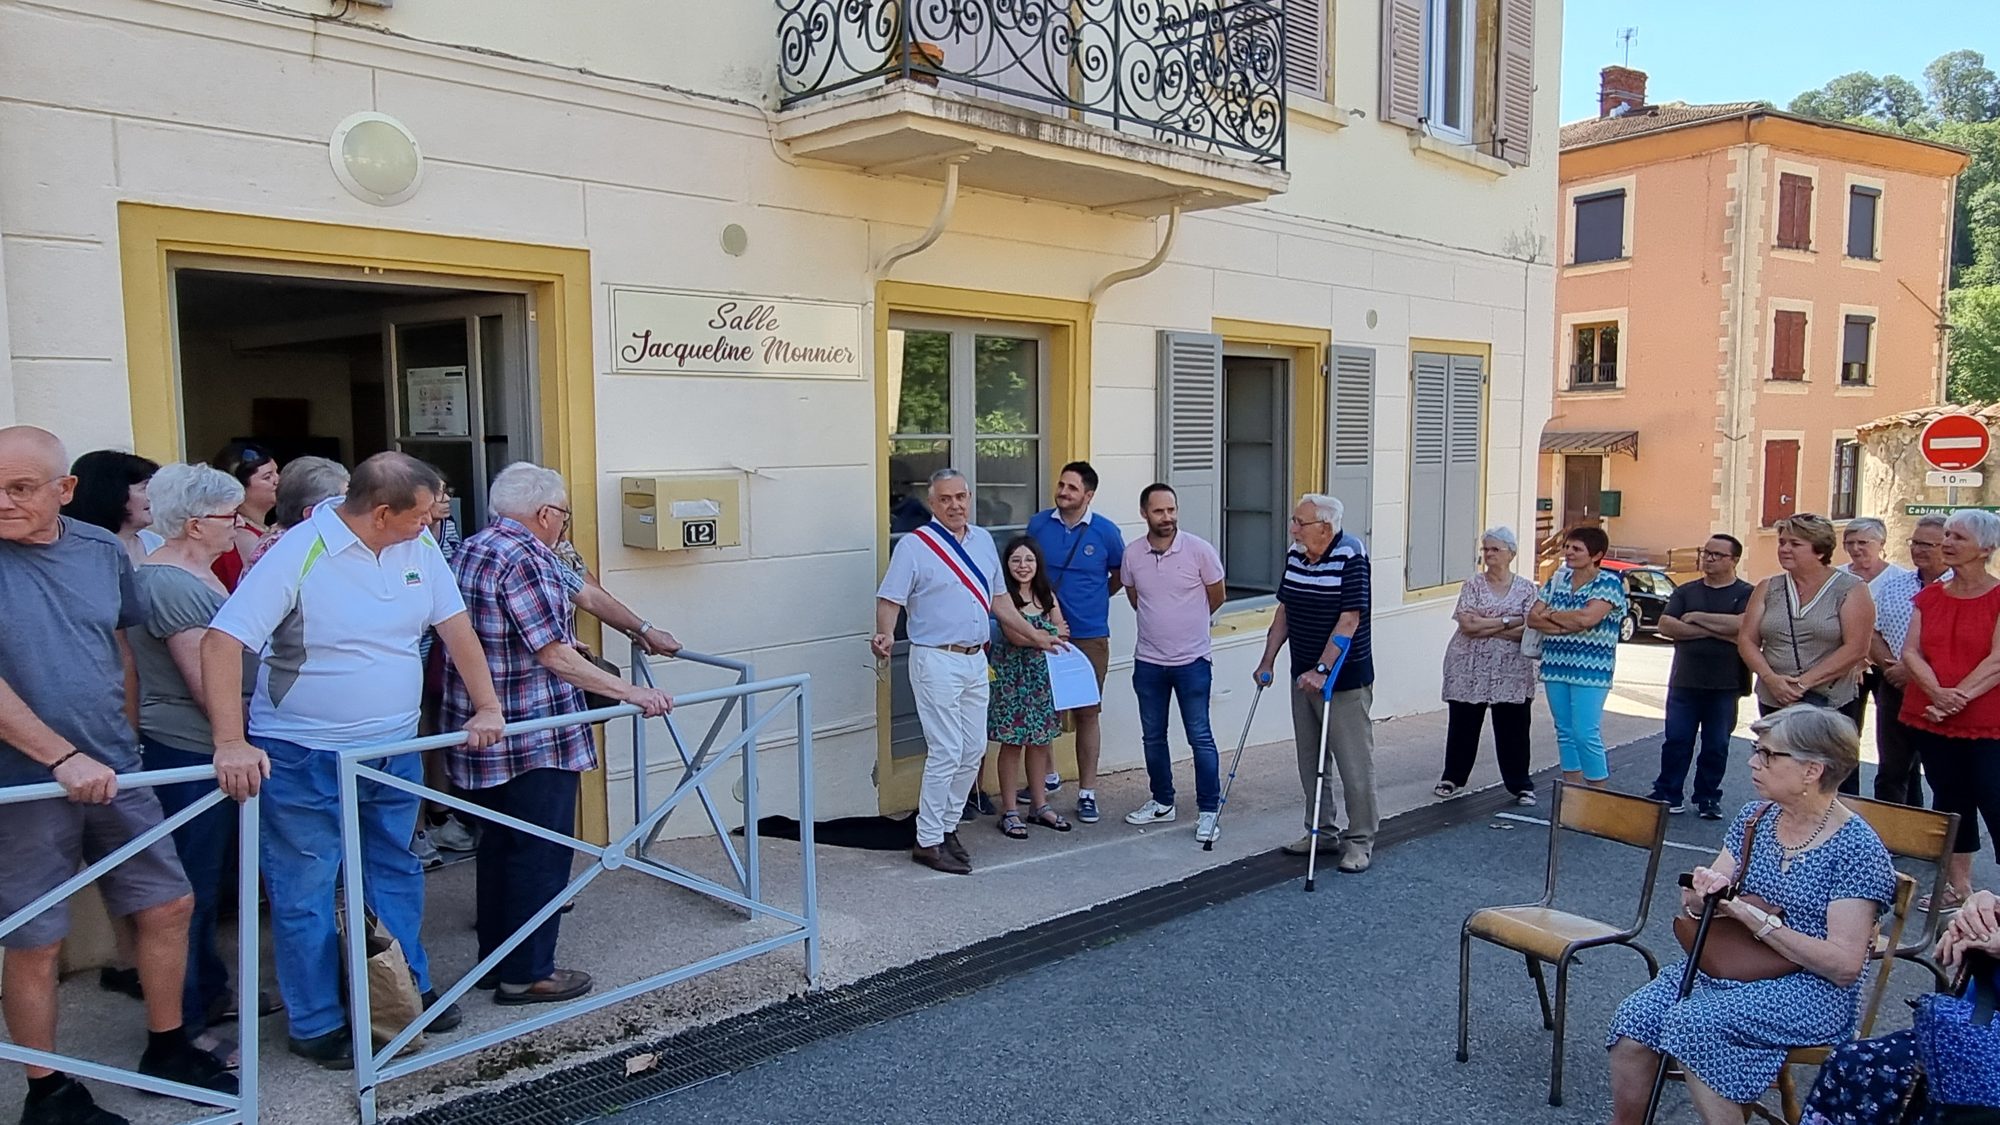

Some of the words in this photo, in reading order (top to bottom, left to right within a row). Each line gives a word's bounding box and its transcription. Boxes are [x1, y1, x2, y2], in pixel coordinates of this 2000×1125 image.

[708, 302, 780, 332] Salle
[621, 329, 754, 367] Jacqueline
[760, 335, 856, 365] Monnier
[1942, 475, 1956, 483] 10
[690, 524, 710, 542] 12
